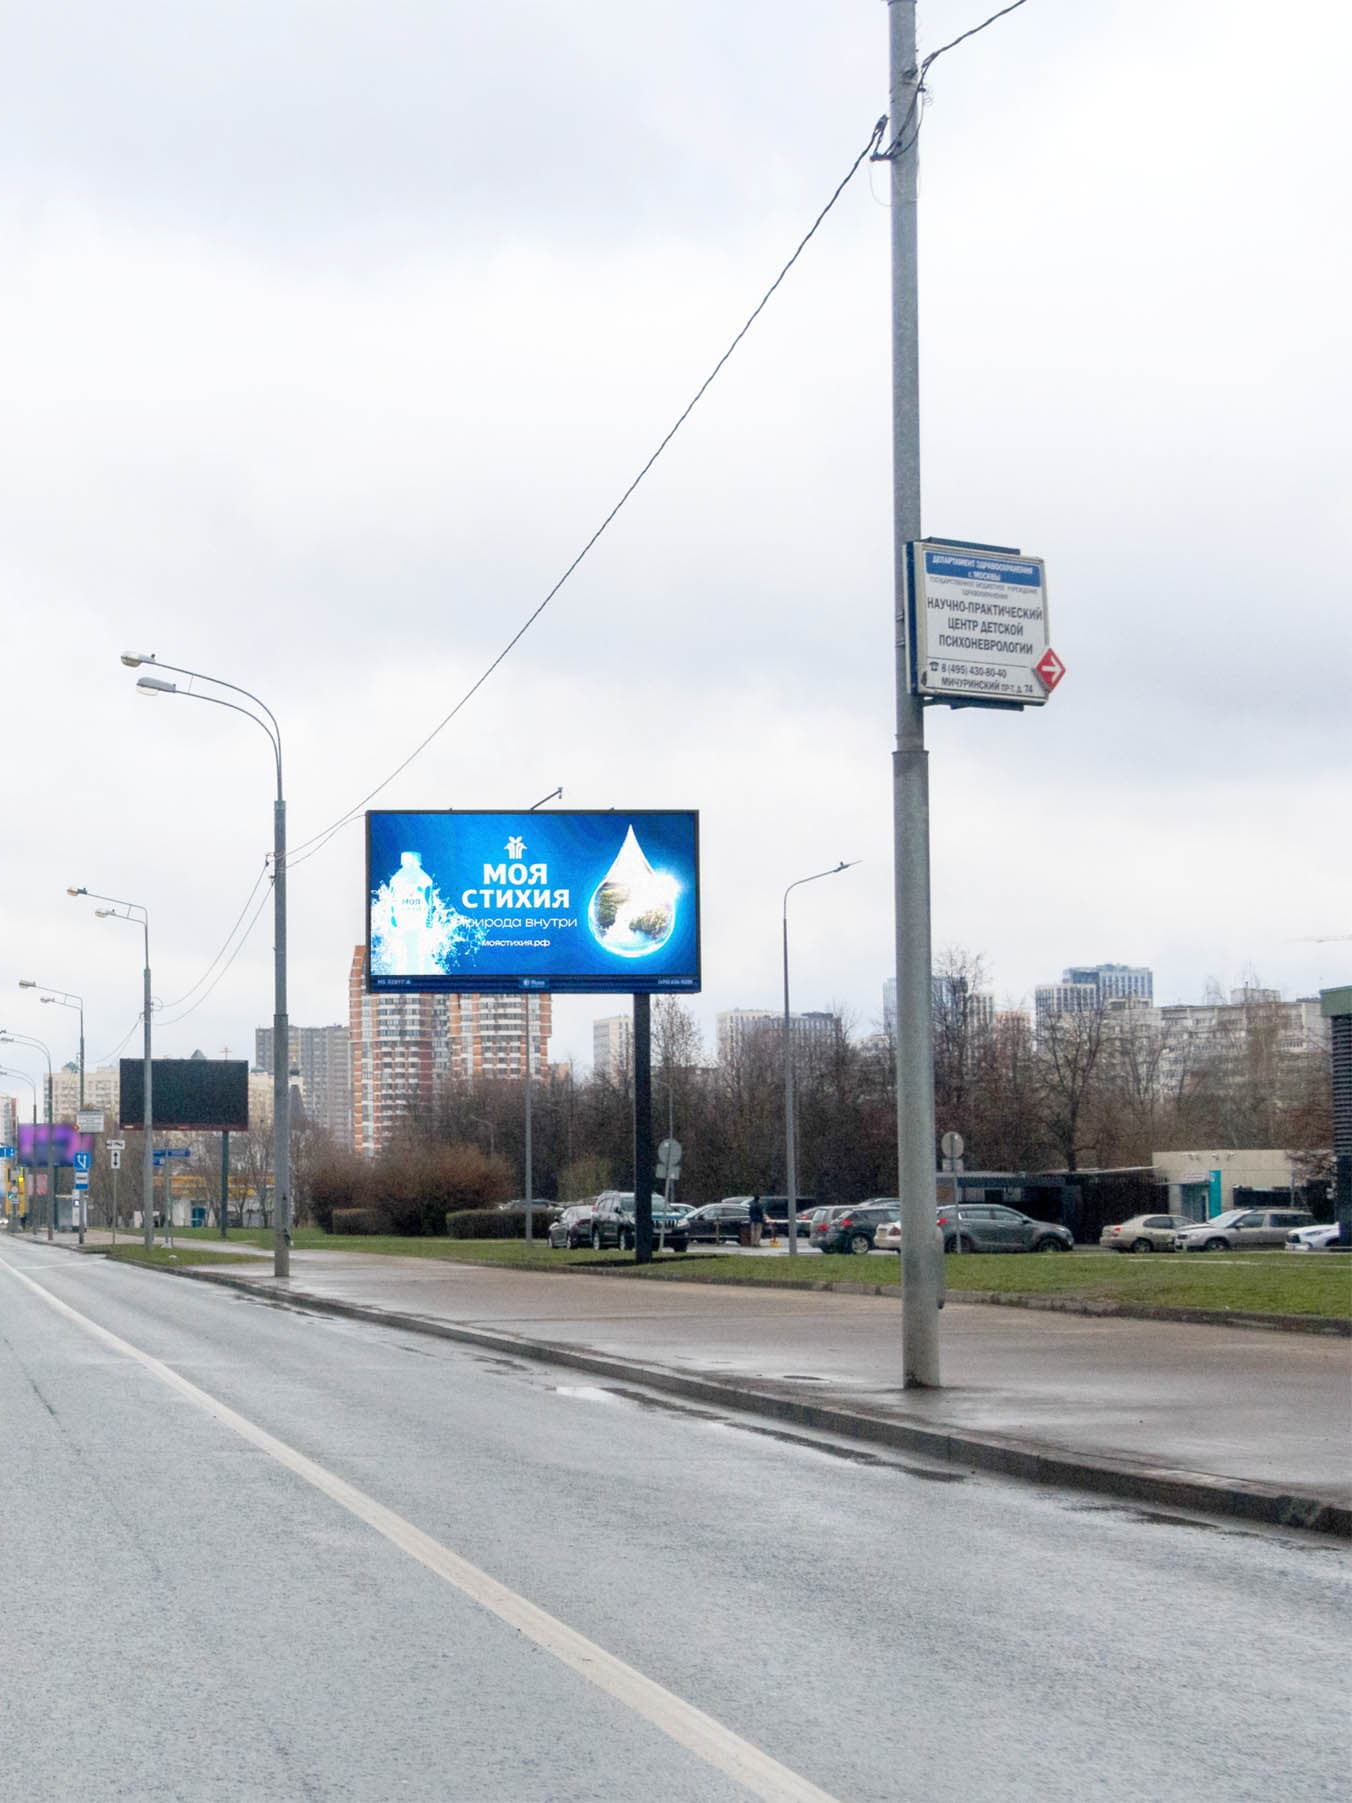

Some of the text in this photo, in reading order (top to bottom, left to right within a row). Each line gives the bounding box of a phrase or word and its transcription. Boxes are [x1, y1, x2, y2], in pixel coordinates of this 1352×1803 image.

[927, 597, 1043, 621] НАУЧНО-ПРАКТИЧЕСКИЙ
[948, 617, 1024, 636] ЦЕНТР ДЕТСКОЙ
[938, 634, 1034, 655] ПСИХОНЕВРОЛОГИИ
[941, 677, 1000, 691] МИЧУРИНСКИЙ
[483, 863, 548, 885] МОЯ
[461, 888, 570, 909] СТИХИЯ
[525, 918, 578, 929] внутри
